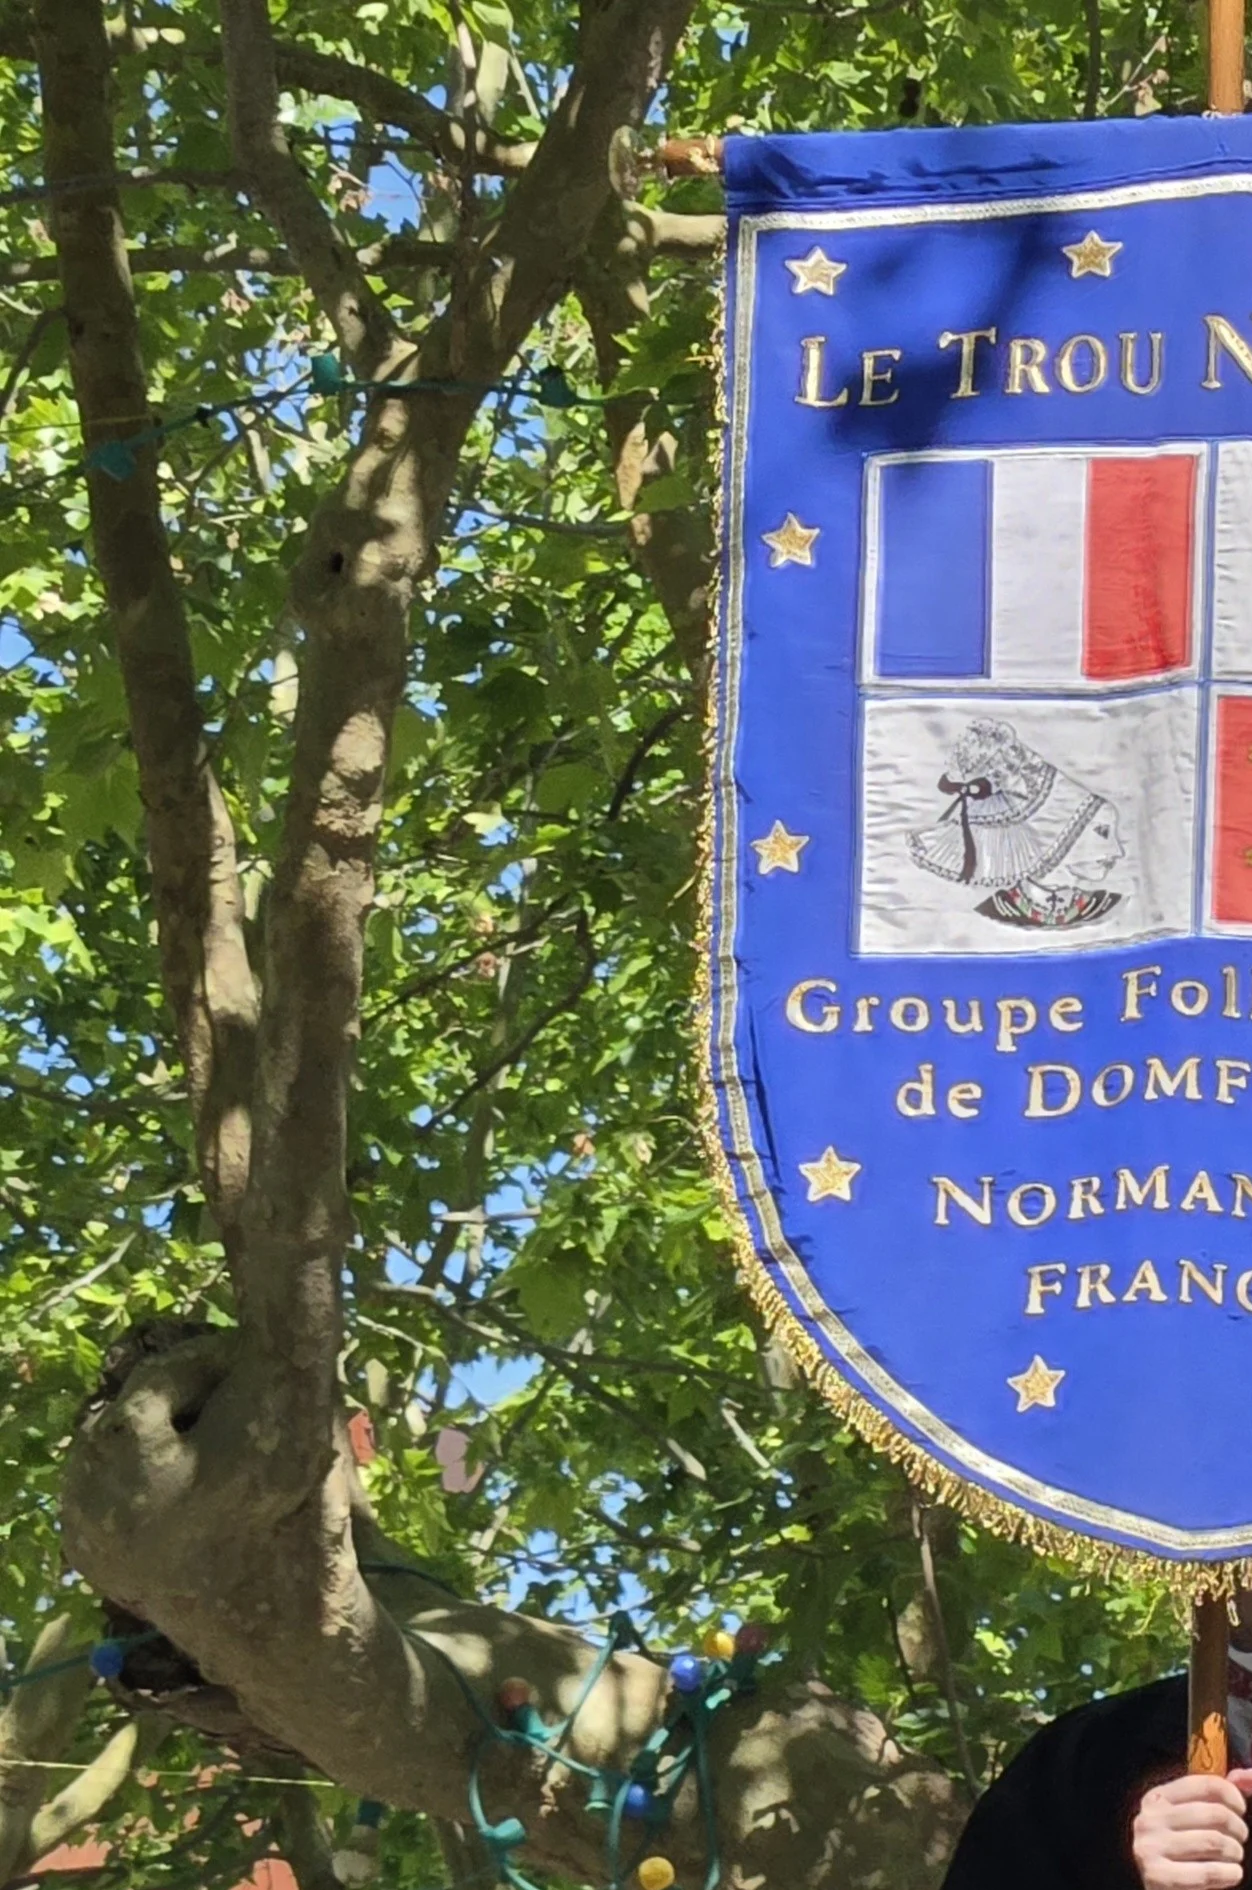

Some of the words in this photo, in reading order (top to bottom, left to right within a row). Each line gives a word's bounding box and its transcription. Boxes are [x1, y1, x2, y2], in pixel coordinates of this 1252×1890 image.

[794, 335, 901, 406] LE
[941, 326, 1162, 399] TROU
[786, 979, 1084, 1051] Groupe
[896, 1062, 982, 1120] de
